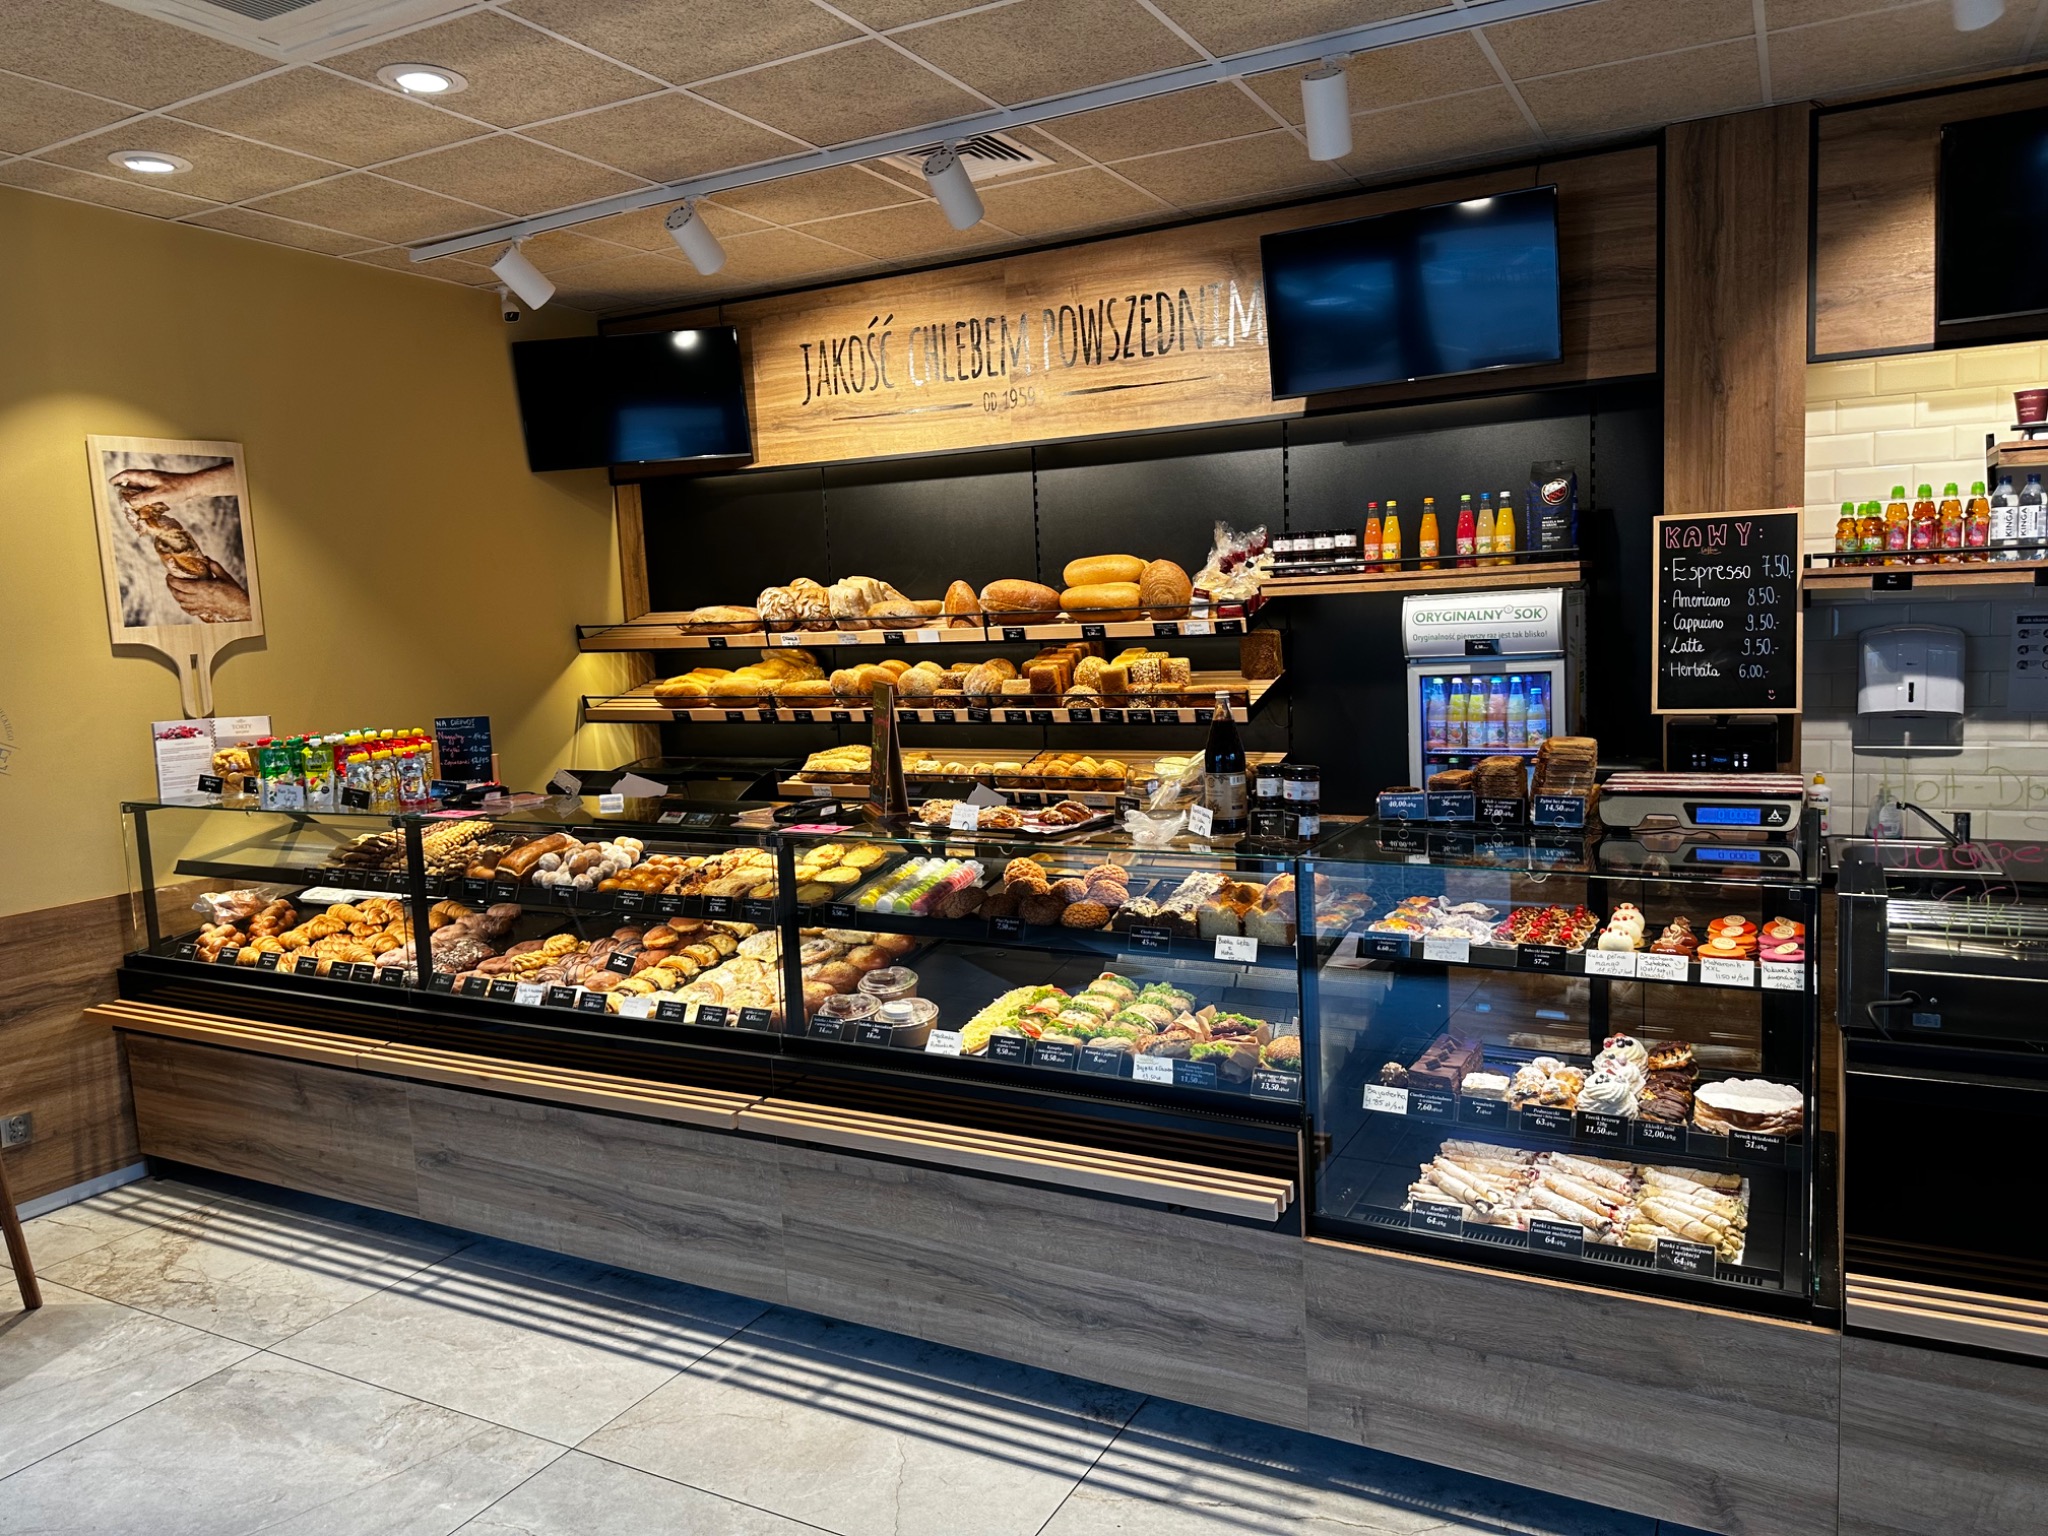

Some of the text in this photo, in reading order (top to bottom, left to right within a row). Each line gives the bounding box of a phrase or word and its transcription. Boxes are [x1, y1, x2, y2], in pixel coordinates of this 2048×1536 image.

[800, 278, 1268, 405] JAKOŚĆ CHLEBEM POWSZEDNIM
[982, 386, 1036, 413] OD 1959
[2005, 508, 2013, 538] KINGA
[1672, 557, 1751, 588] Espresso
[1672, 590, 1731, 608] Americano
[1415, 607, 1543, 624] ORYGINALNY SOK
[1412, 632, 1456, 642] Oryginalność
[1456, 631, 1486, 641] pierwszy
[1524, 629, 1548, 638] blisko!
[1670, 637, 1706, 653] Latte
[1670, 662, 1721, 677] Herbata
[1595, 961, 1620, 969] mango
